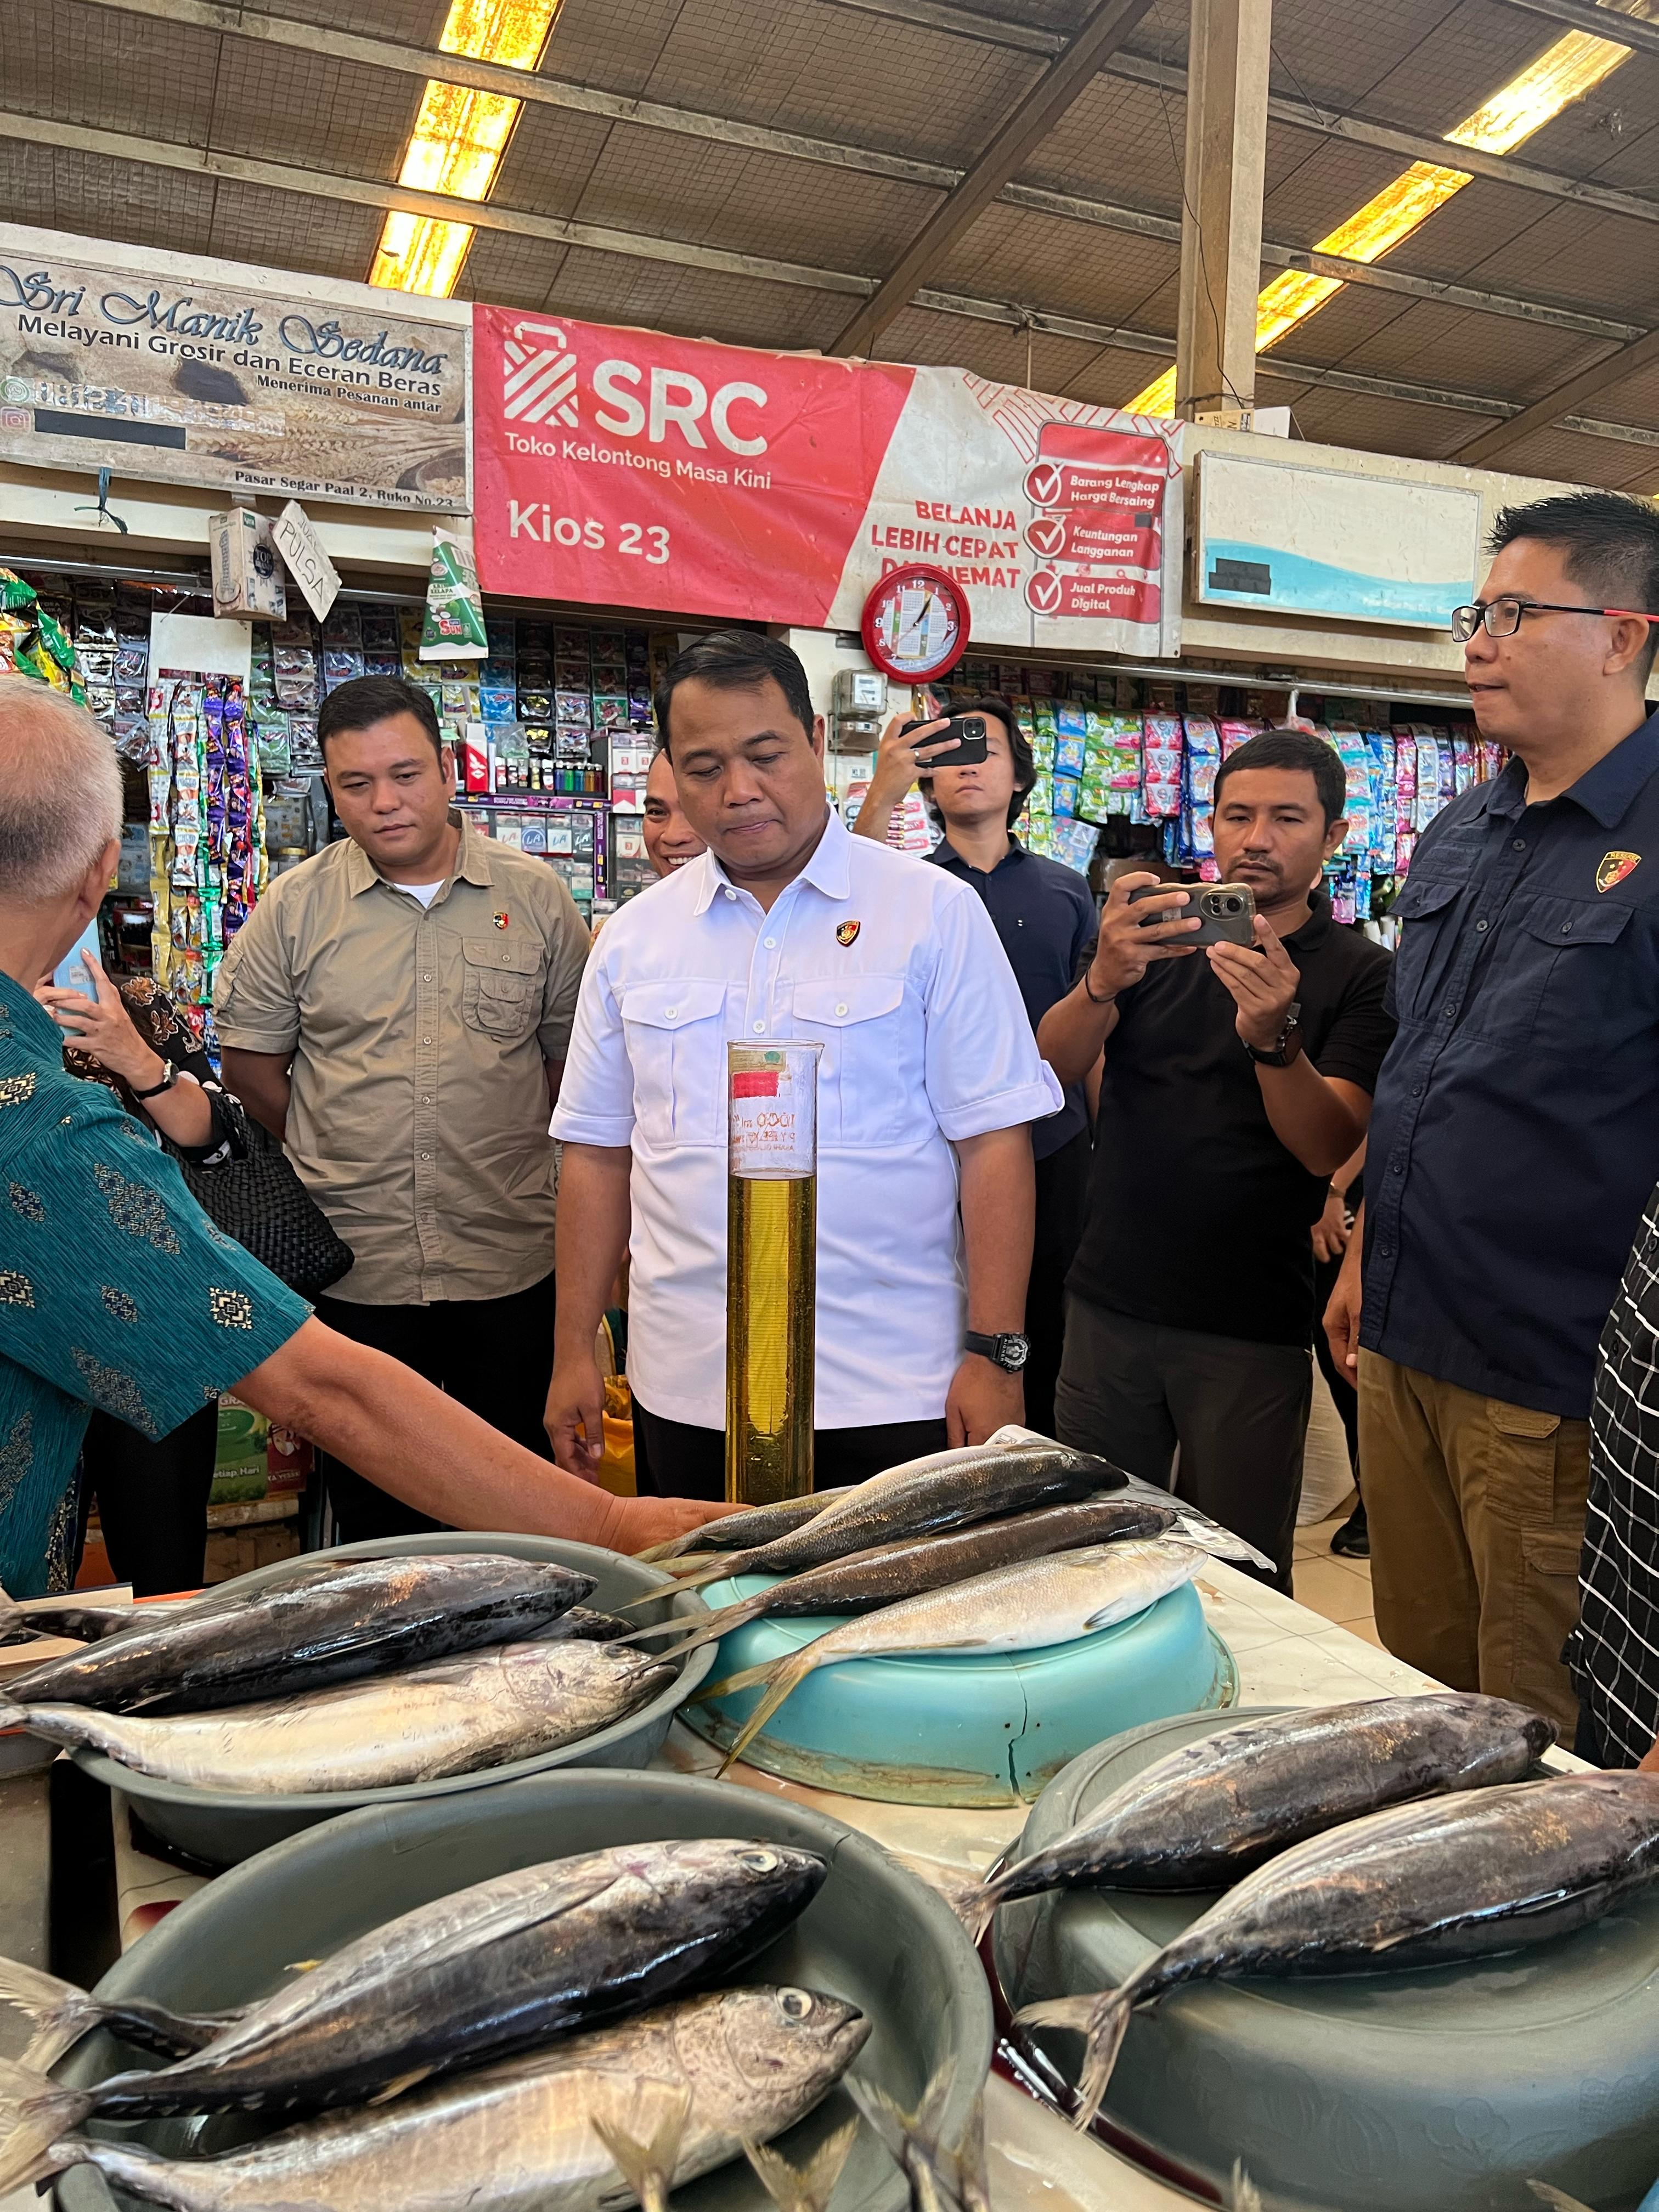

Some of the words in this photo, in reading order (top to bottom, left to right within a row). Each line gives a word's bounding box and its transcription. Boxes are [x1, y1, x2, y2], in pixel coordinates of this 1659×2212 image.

[0, 264, 86, 317] Sri
[100, 290, 263, 346] Manik
[279, 314, 448, 375] Sedana
[18, 314, 139, 347] Melayani
[148, 335, 225, 362] Grosir
[233, 350, 280, 371] dan
[289, 358, 370, 385] Eceran
[379, 372, 441, 396] Beras
[257, 375, 331, 396] Menerima
[337, 387, 398, 407] Pesanan
[404, 399, 442, 413] antar
[592, 359, 768, 456] SRC
[505, 432, 556, 457] Toko
[562, 441, 671, 477] Kelontong
[676, 462, 727, 485] Masa
[734, 469, 771, 489] Kini
[235, 471, 276, 486] Pasar
[280, 477, 320, 492] Segar
[325, 483, 354, 496] Paal
[377, 490, 411, 503] Ruko
[1070, 475, 1113, 489] Barang
[1115, 477, 1159, 493] Lengkap
[1071, 492, 1108, 503] Harga
[1109, 492, 1155, 509] Bersaing
[916, 500, 1017, 531] BELANJA
[509, 500, 605, 549] Kios
[619, 523, 670, 564] 23
[871, 524, 940, 554] LEBIH
[945, 535, 1019, 558] CEPAT
[1073, 526, 1138, 544] Keuntungan
[1071, 542, 1134, 558] Langganan
[280, 519, 324, 603] PULSA
[913, 580, 925, 588] 12
[1070, 582, 1095, 594] Jual
[945, 603, 952, 611] 2
[1071, 597, 1110, 612] Digital
[874, 618, 883, 628] 9
[947, 621, 955, 631] 3
[526, 832, 540, 844] LA
[553, 834, 567, 846] LA
